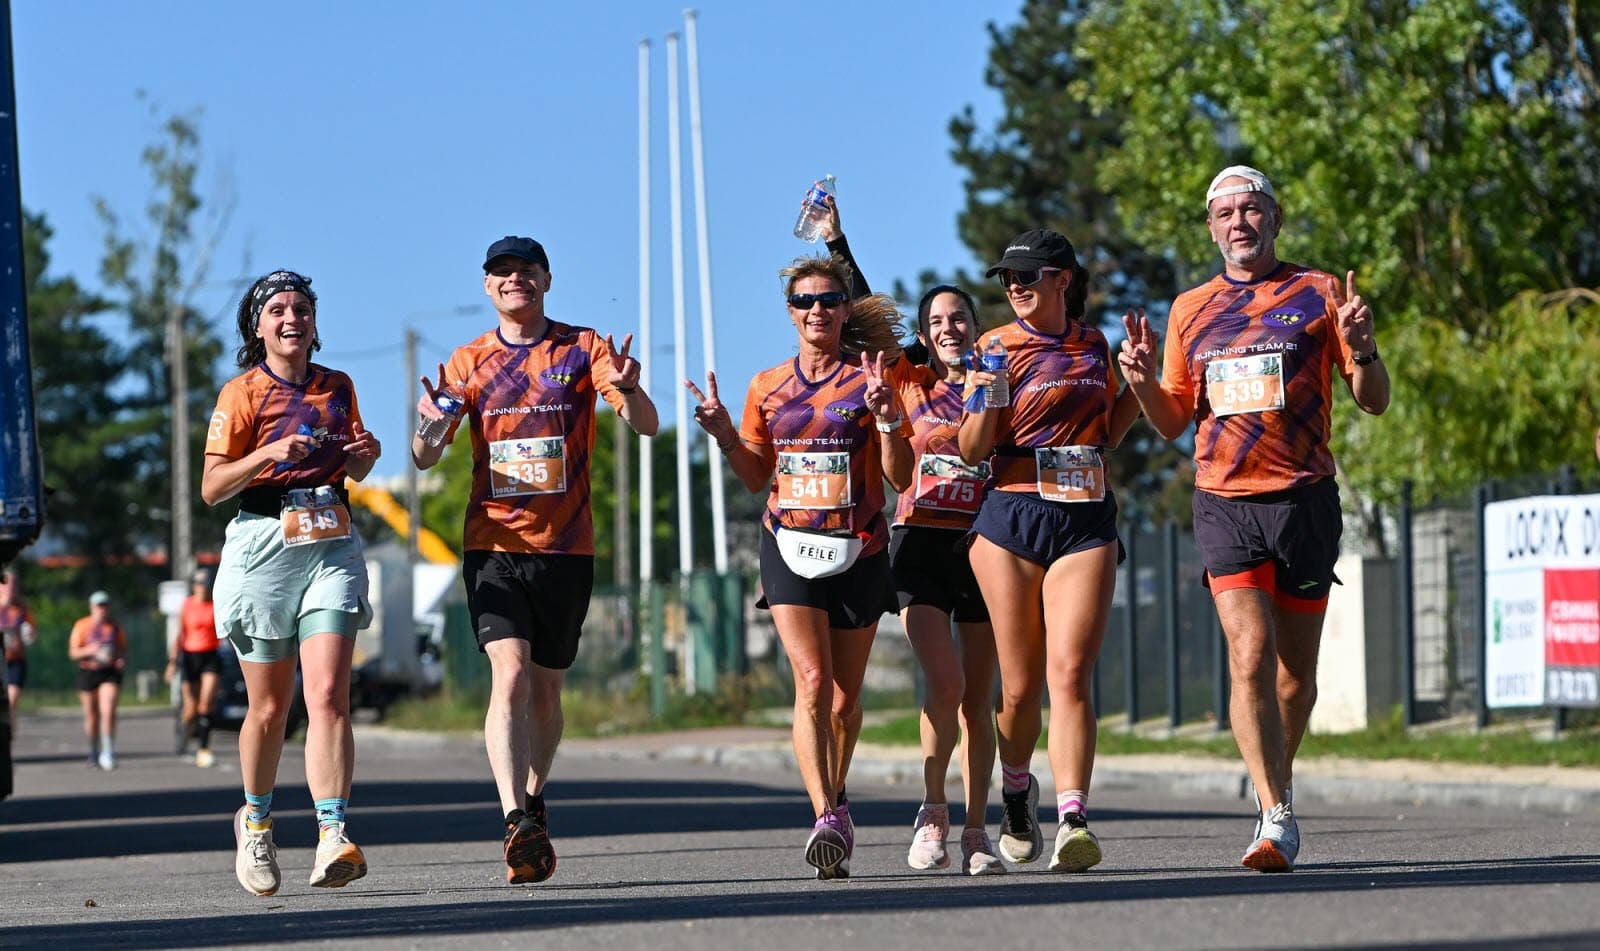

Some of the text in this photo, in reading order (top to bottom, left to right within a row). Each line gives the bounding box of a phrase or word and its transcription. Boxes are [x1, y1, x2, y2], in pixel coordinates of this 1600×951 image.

[1194, 342, 1298, 361] RUNNING TEAM 21
[1028, 379, 1078, 392] RUNNING
[1223, 380, 1264, 404] 539
[532, 403, 562, 412] TEAM
[923, 415, 962, 428] RUNNIN
[814, 438, 844, 446] TEAM
[507, 462, 548, 485] 535
[1057, 470, 1096, 492] 564
[791, 477, 829, 498] 541
[936, 479, 975, 503] 175
[298, 509, 339, 534] 549
